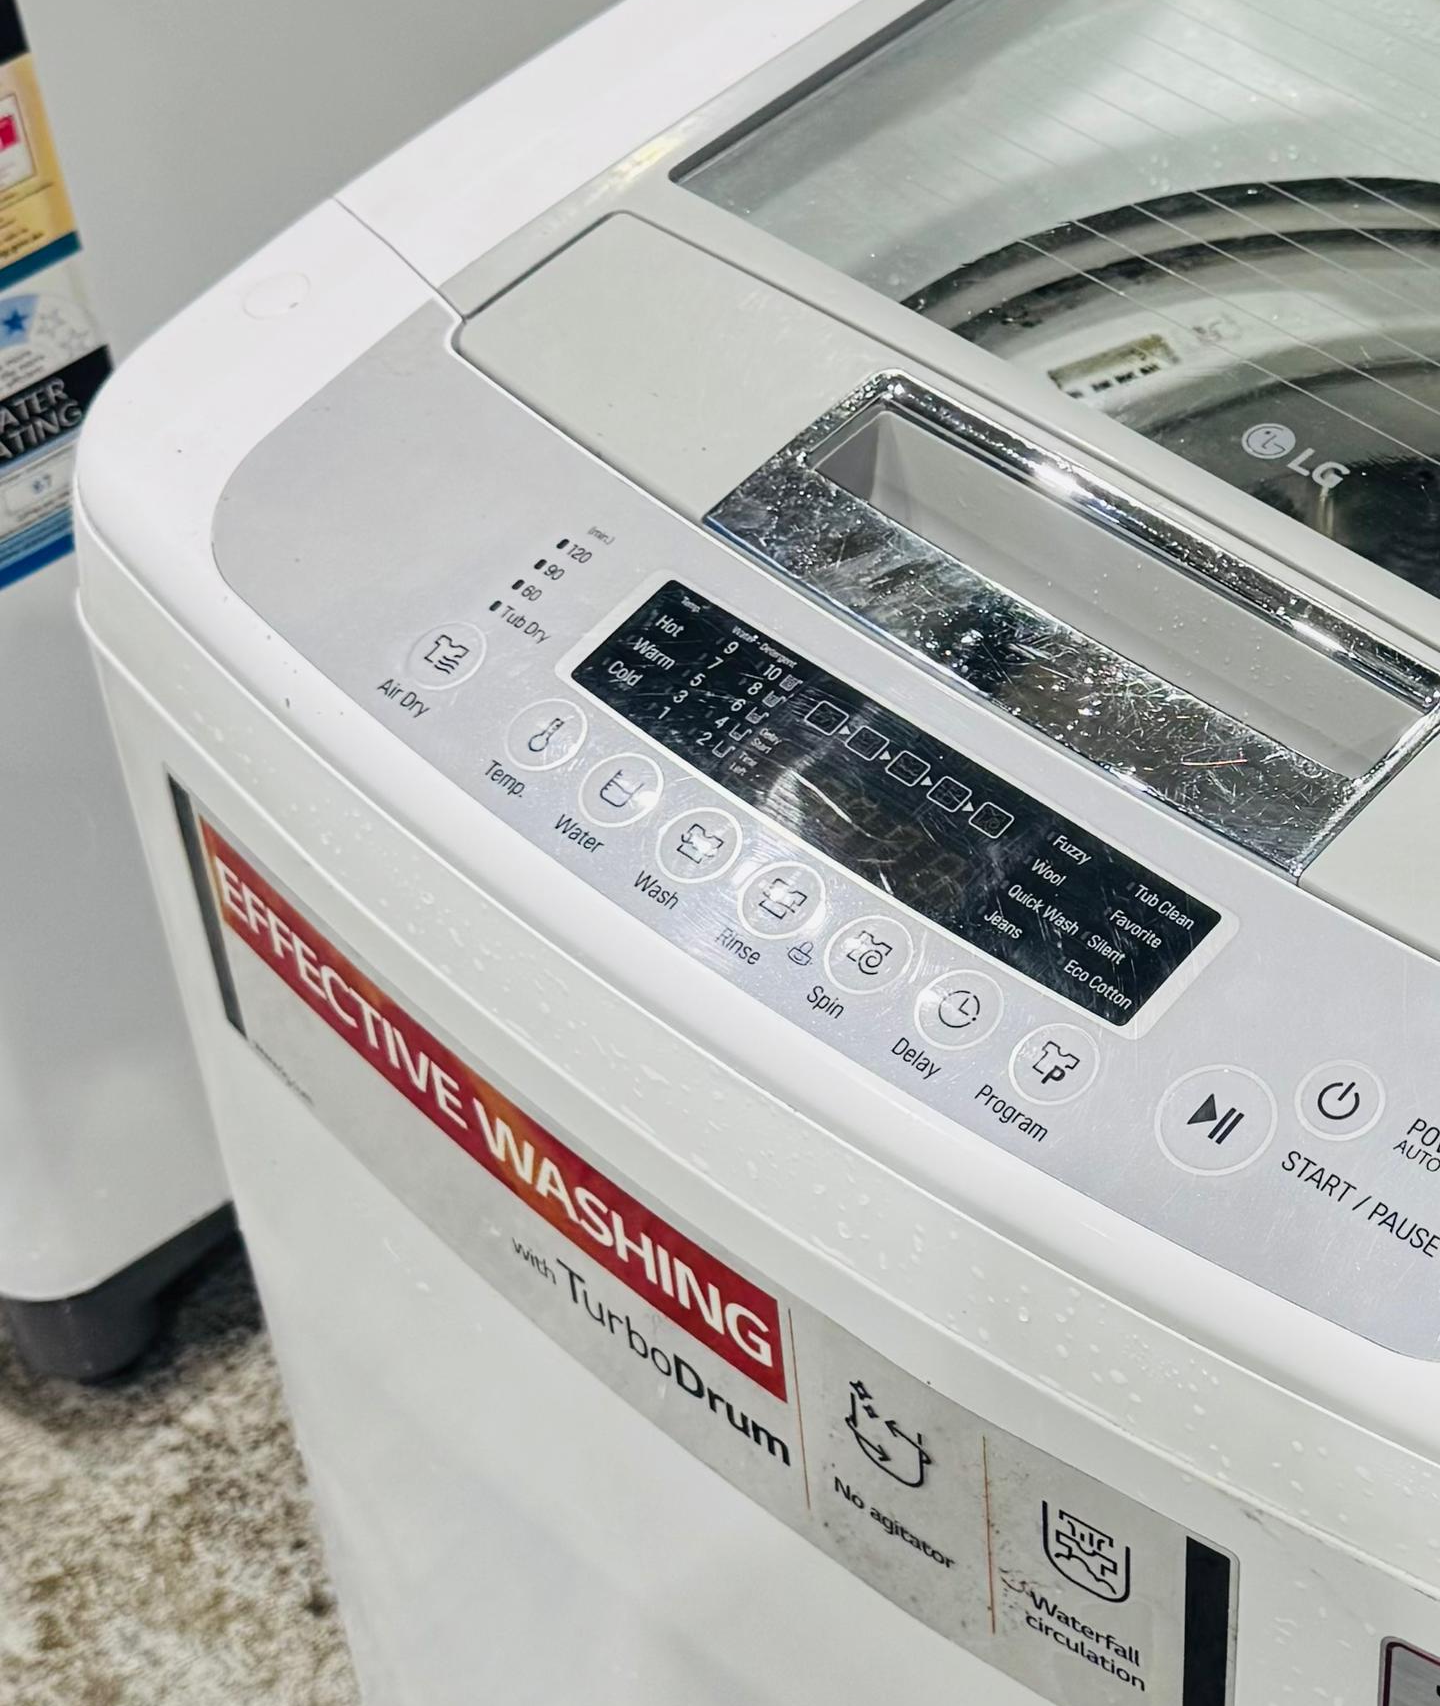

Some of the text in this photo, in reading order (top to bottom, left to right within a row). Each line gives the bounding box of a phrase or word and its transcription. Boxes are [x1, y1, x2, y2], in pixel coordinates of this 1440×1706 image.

[0, 377, 68, 432] ATER
[0, 398, 82, 458] ATING
[1286, 447, 1350, 489] LG
[544, 564, 565, 580] 90
[566, 544, 592, 563] 120
[521, 585, 542, 601] 60
[501, 605, 551, 644] Tub Dry
[655, 614, 685, 638] Hot
[632, 636, 676, 671] Warm
[707, 656, 724, 671] 7
[723, 641, 740, 655] 9
[758, 642, 798, 669] Detergent
[607, 660, 644, 688] Cold
[690, 673, 706, 687] 5
[747, 682, 764, 696] 8
[763, 664, 783, 681] 10
[377, 678, 431, 719] Air Dry
[658, 706, 671, 720] 1
[673, 690, 689, 704] 3
[730, 698, 747, 713] 6
[696, 731, 713, 746] 2
[714, 716, 730, 729] 4
[484, 759, 524, 799] Temp.
[554, 813, 606, 855] Water
[1052, 834, 1092, 866] Fuzzy
[633, 869, 681, 911] Wash
[1031, 857, 1067, 888] Wool
[983, 908, 1024, 940] Jeans
[1007, 883, 1080, 936] Quick Wash
[1133, 884, 1197, 932] Tub Clean
[714, 927, 762, 966] Rinse
[1108, 908, 1164, 951] Favorite
[1087, 933, 1127, 967] Silent
[806, 984, 846, 1021] Spin
[1063, 958, 1133, 1012] Eco Cotton
[890, 1036, 942, 1081] Delay
[213, 856, 775, 1370] EFFECTIVE WASHING
[974, 1084, 1050, 1145] Program
[1281, 1150, 1357, 1204] START
[512, 1236, 792, 1467] with TurboDrum
[833, 1476, 956, 1570] No agitator
[1029, 1591, 1141, 1667] Waterfall
[1025, 1613, 1146, 1692] circulation
